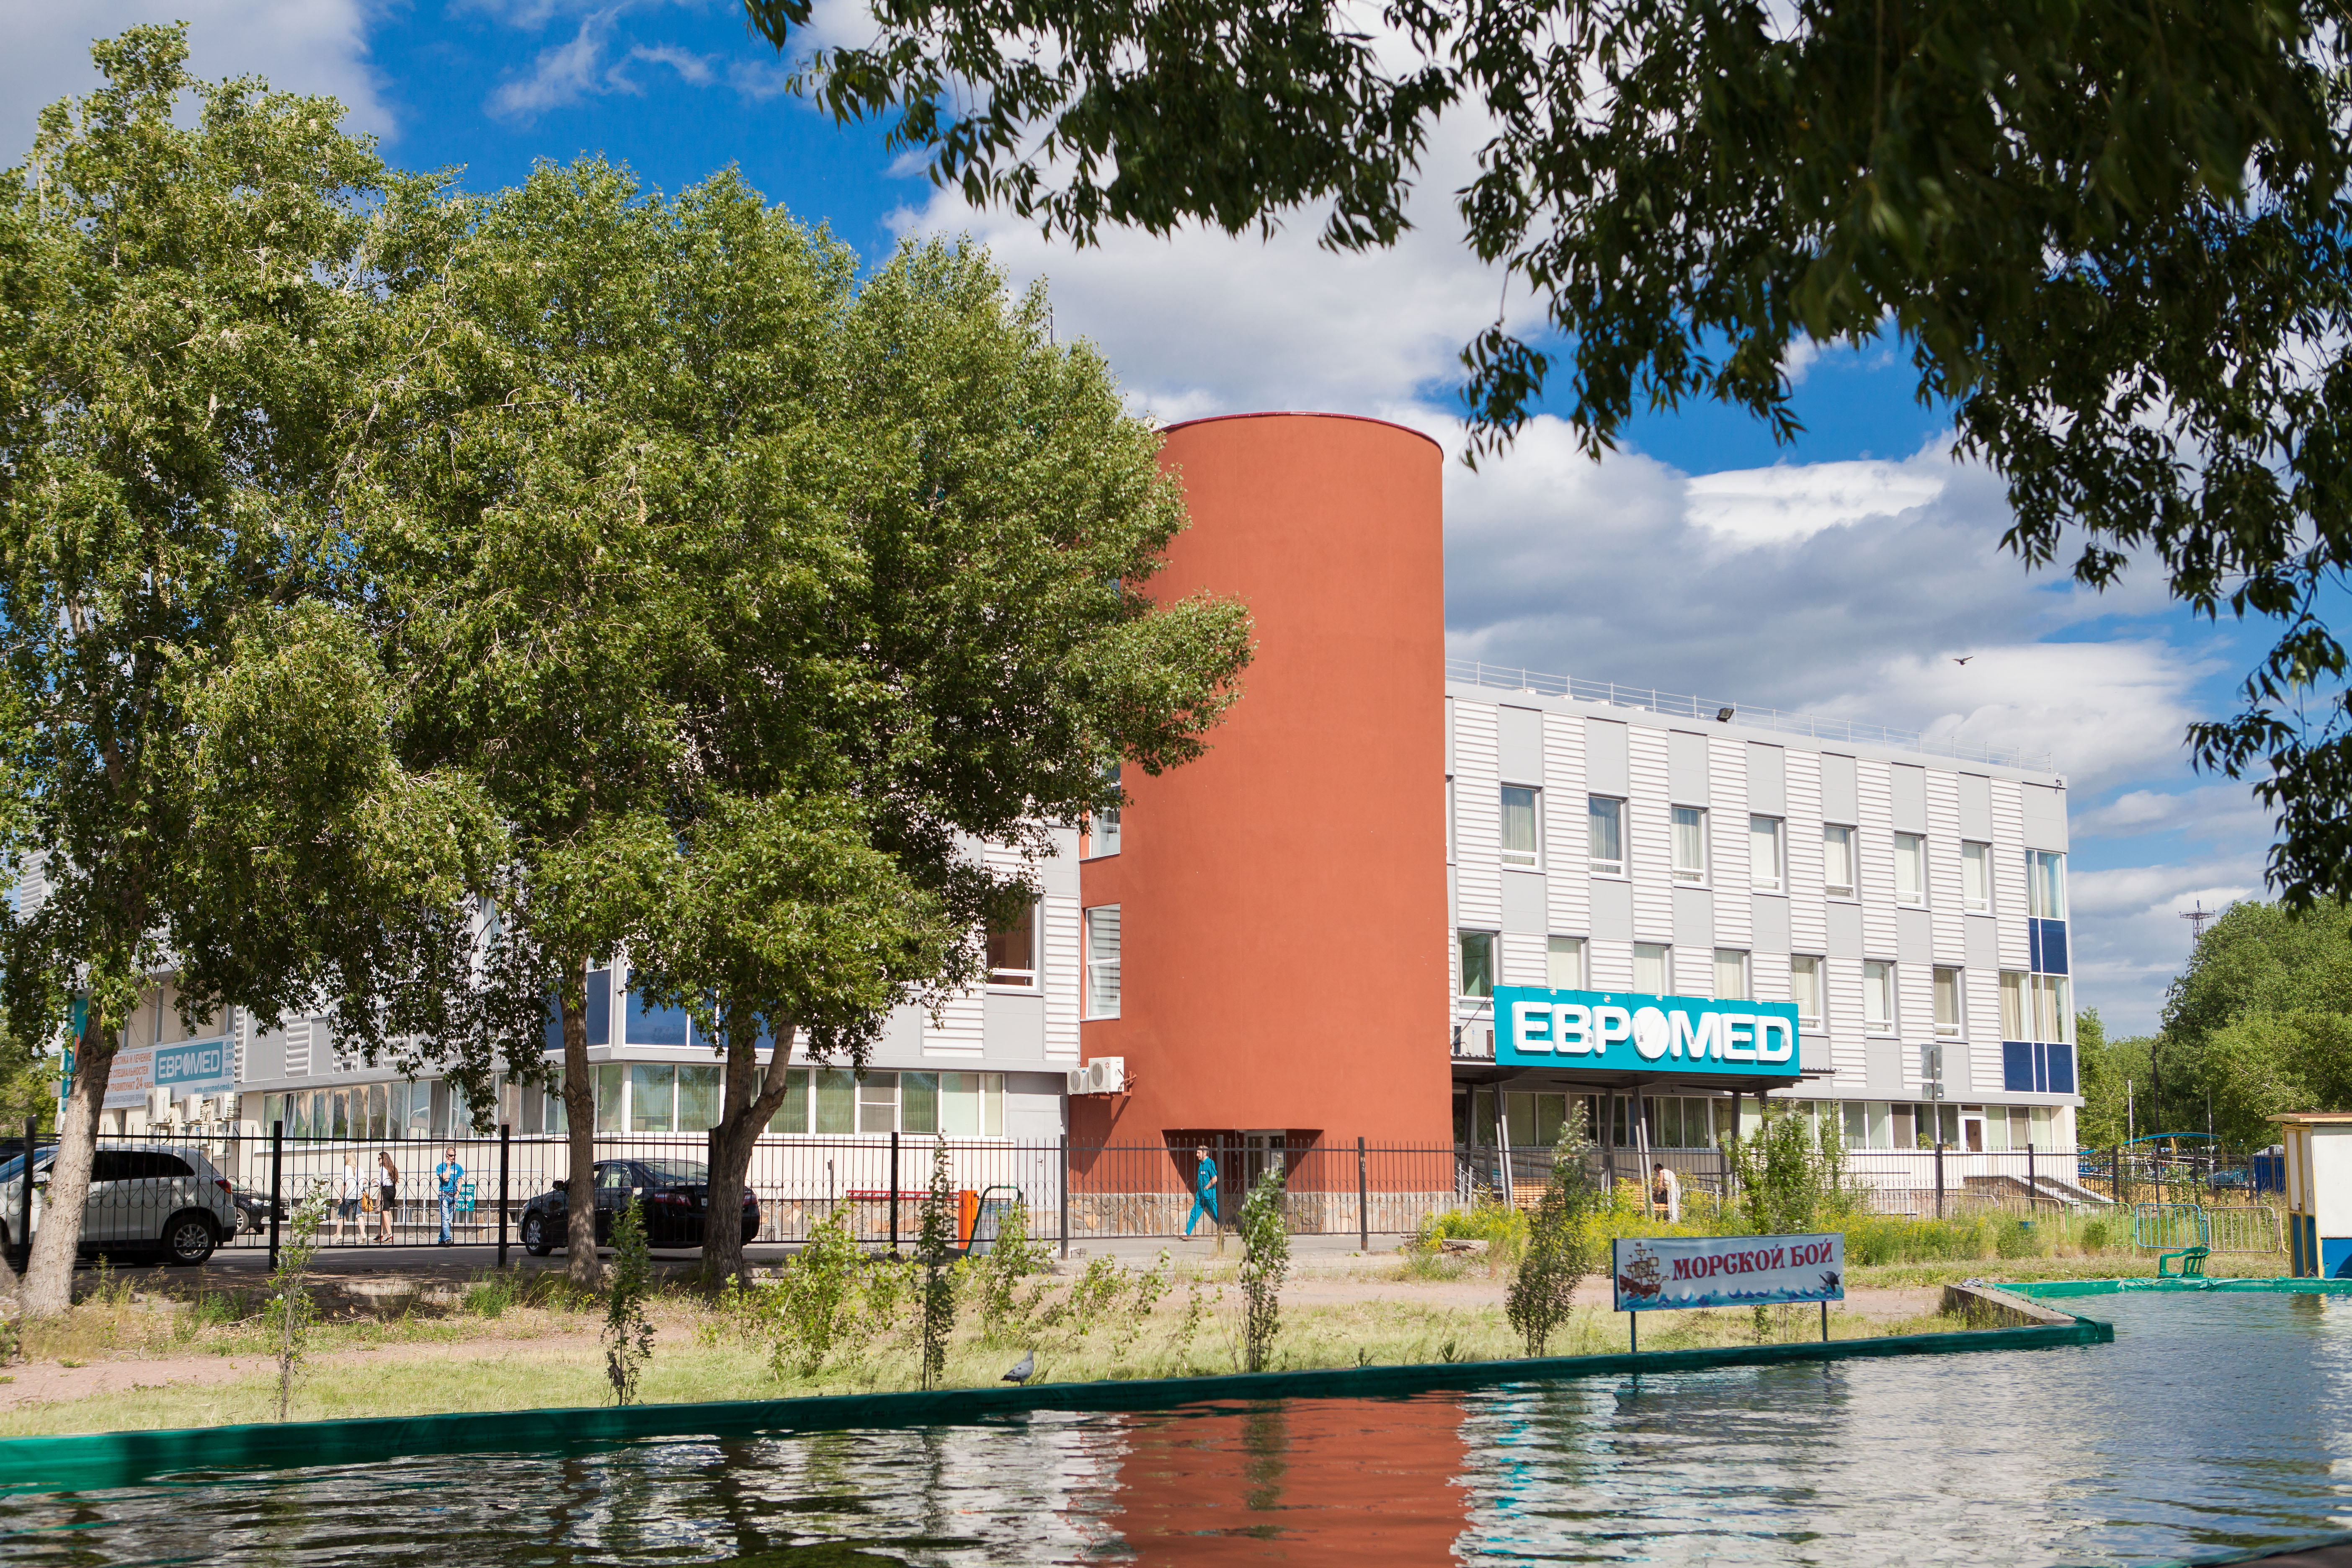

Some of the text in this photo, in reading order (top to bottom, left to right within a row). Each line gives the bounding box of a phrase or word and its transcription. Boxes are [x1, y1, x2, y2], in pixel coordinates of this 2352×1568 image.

[134, 1052, 152, 1063] ЛЕЧЕНИЕ
[113, 1063, 149, 1078] СПЕЦИАЛЬНОСТЕЙ
[110, 1081, 135, 1092] ТРАВМПУНКТ
[136, 1076, 143, 1090] 24
[1672, 1238, 1834, 1281] МОРСКОЙ БОЙ
